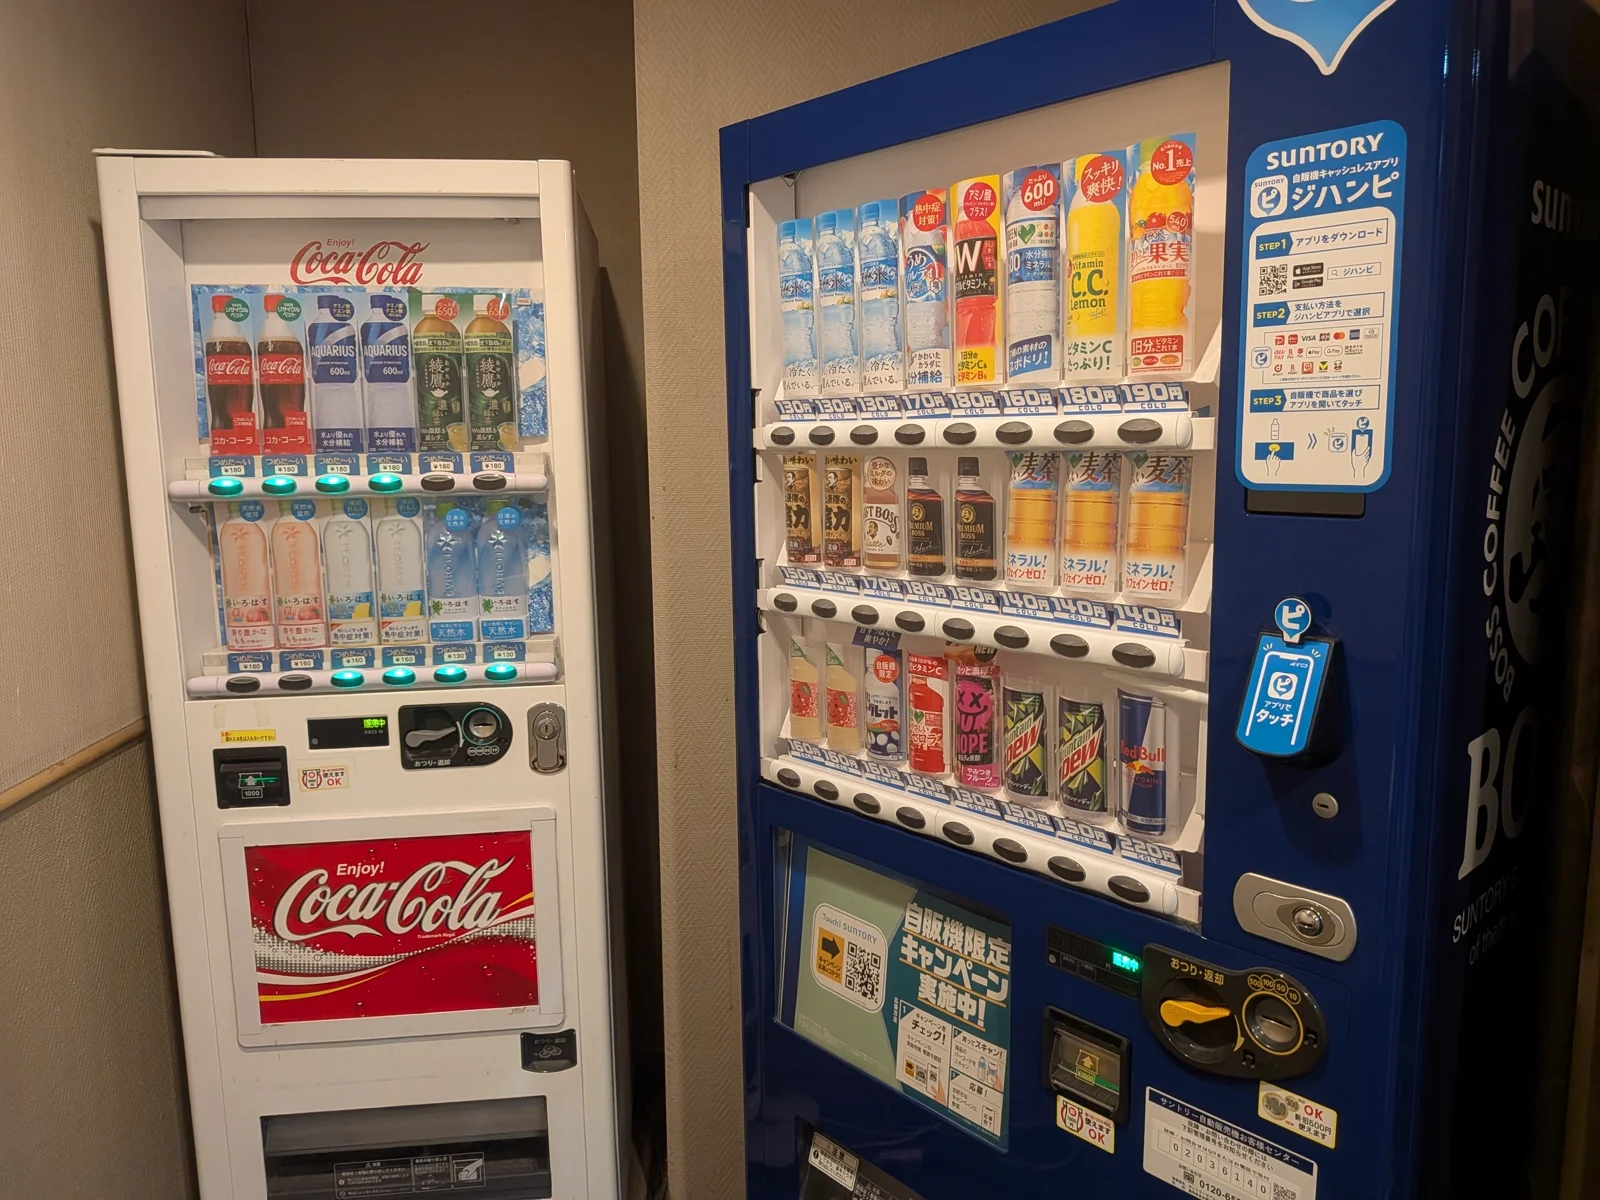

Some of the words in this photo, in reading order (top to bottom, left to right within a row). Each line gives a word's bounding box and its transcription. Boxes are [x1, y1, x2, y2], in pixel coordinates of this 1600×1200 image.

[1266, 132, 1385, 171] SUNTORY
[1082, 159, 1119, 183] スッキリ
[1292, 156, 1399, 184] 自販機キャッシュレスアプリ
[1028, 173, 1047, 185] たっぷり
[1254, 177, 1285, 188] SUNTORY
[968, 189, 992, 201] アミノ酸
[1023, 180, 1054, 203] 600
[1086, 175, 1123, 202] 爽快!
[1291, 171, 1400, 212] ジハンピ
[914, 201, 941, 215] 熱中症
[1033, 197, 1046, 208] ml!
[917, 214, 940, 226] 対策!
[969, 207, 988, 217] プラス!
[1168, 214, 1187, 226] 540
[326, 238, 355, 247] Enjoy!
[1295, 227, 1383, 247] アプリをダウンロード
[290, 240, 431, 285] Coca-Cola
[907, 253, 927, 271] うめ
[956, 240, 982, 274] W
[1343, 265, 1374, 277] ジハンピ
[1071, 268, 1110, 298] C.C.
[1070, 298, 1106, 311] Lemon
[1294, 300, 1342, 312] 支払い方法を
[1294, 307, 1371, 322] ジハンピアプリで選択
[311, 344, 355, 357] AQUARIUS
[364, 344, 408, 357] AQUARIUS
[917, 352, 941, 361] かわいた
[1067, 340, 1113, 356] ビタミンC
[208, 357, 250, 376] Coca-Cola
[261, 357, 302, 376] Coca-Cola
[918, 360, 941, 369] カラダに
[1067, 355, 1111, 372] たっぷり!
[429, 357, 446, 388] 綾鷹
[480, 357, 497, 388] 綾鷹
[947, 392, 996, 408] 180円
[1000, 389, 1053, 407] 160円
[1059, 386, 1117, 404] 180円
[1120, 382, 1184, 402] 190円
[1290, 388, 1363, 400] 自販機で商品を選び
[776, 400, 812, 414] 130円
[815, 399, 854, 413] 130円
[856, 397, 899, 412] 130円
[902, 393, 944, 410] 170円
[1289, 400, 1363, 410] アプリを開いてタッチ
[213, 436, 253, 445] コカ・コーラ
[266, 435, 305, 444] コカ・コーラ
[320, 431, 354, 439] 水より優れた
[322, 439, 351, 447] 水分補給
[373, 431, 407, 439] 水より優れた
[223, 466, 242, 474] ¥180
[870, 469, 892, 478] ミルクの
[1021, 451, 1060, 481] 麦茶
[1080, 451, 1123, 484] 麦茶
[1483, 407, 1516, 597] COFFEE
[960, 532, 976, 540] BOSS
[1063, 556, 1109, 573] ミネラル!
[1126, 561, 1175, 579] ミネラル!
[781, 567, 817, 582] 150円
[818, 571, 856, 587] 150円
[860, 576, 901, 592] 170円
[903, 581, 947, 597] 180円
[949, 586, 995, 604] 180円
[1000, 591, 1050, 611] 140円
[1016, 608, 1037, 616] COLD
[1050, 596, 1107, 618] 140円
[1114, 604, 1175, 627] 140円
[1068, 613, 1092, 622] COLD
[1281, 604, 1306, 630] ピ
[438, 628, 467, 637] 天然水
[488, 626, 518, 635] 天然水
[1132, 621, 1158, 631] COLD
[863, 635, 890, 647] 爽やか!
[1486, 604, 1516, 704] BOSS
[876, 660, 896, 671] 自販機
[878, 670, 893, 679] 限定
[1276, 677, 1292, 693] ピ
[1263, 700, 1292, 712] アプリで
[1255, 708, 1294, 728] タッチ
[786, 738, 822, 757] 160円
[1140, 746, 1165, 763] Bull
[822, 748, 859, 769] 160円
[861, 760, 901, 780] 160円
[966, 774, 993, 783] フルーツ
[967, 767, 992, 776] やみつき
[326, 777, 343, 787] OK
[903, 772, 946, 794] 160円
[951, 787, 997, 809] 130円
[1000, 801, 1051, 825] 150円
[1052, 816, 1108, 842] 150円
[1118, 836, 1178, 863] 220円
[1136, 853, 1161, 865] COLD
[336, 861, 385, 877] Enjoy!
[274, 855, 515, 941] Coca-Cola
[822, 912, 842, 929] Touch!
[842, 921, 878, 944] SUNTORY
[903, 902, 1012, 972] 自販機限定
[818, 955, 842, 972] キャンペーン
[900, 934, 1009, 1002] キャンペーン
[1169, 956, 1225, 987] おつり・返却
[1262, 977, 1274, 989] 100
[1275, 983, 1286, 993] 50
[917, 972, 986, 1028] 実施中!
[1288, 991, 1298, 1001] 10
[915, 1012, 947, 1033] キャンペーンを
[911, 1019, 946, 1046] チェック!
[961, 1035, 1003, 1060] 買ってスキャン!
[968, 1082, 988, 1098] 応募!
[1303, 1104, 1324, 1122] OK
[1084, 1116, 1112, 1135] 使えます
[1159, 1096, 1300, 1165] サントリー自動販売機お客様センター
[1294, 1113, 1332, 1136] 新旧500円
[1298, 1122, 1328, 1140] 使えます
[1088, 1128, 1106, 1146] OK
[1187, 1120, 1268, 1162] 故障・お問い合わせの際には
[1181, 1123, 1274, 1171] 下記管理番号をお知らせください
